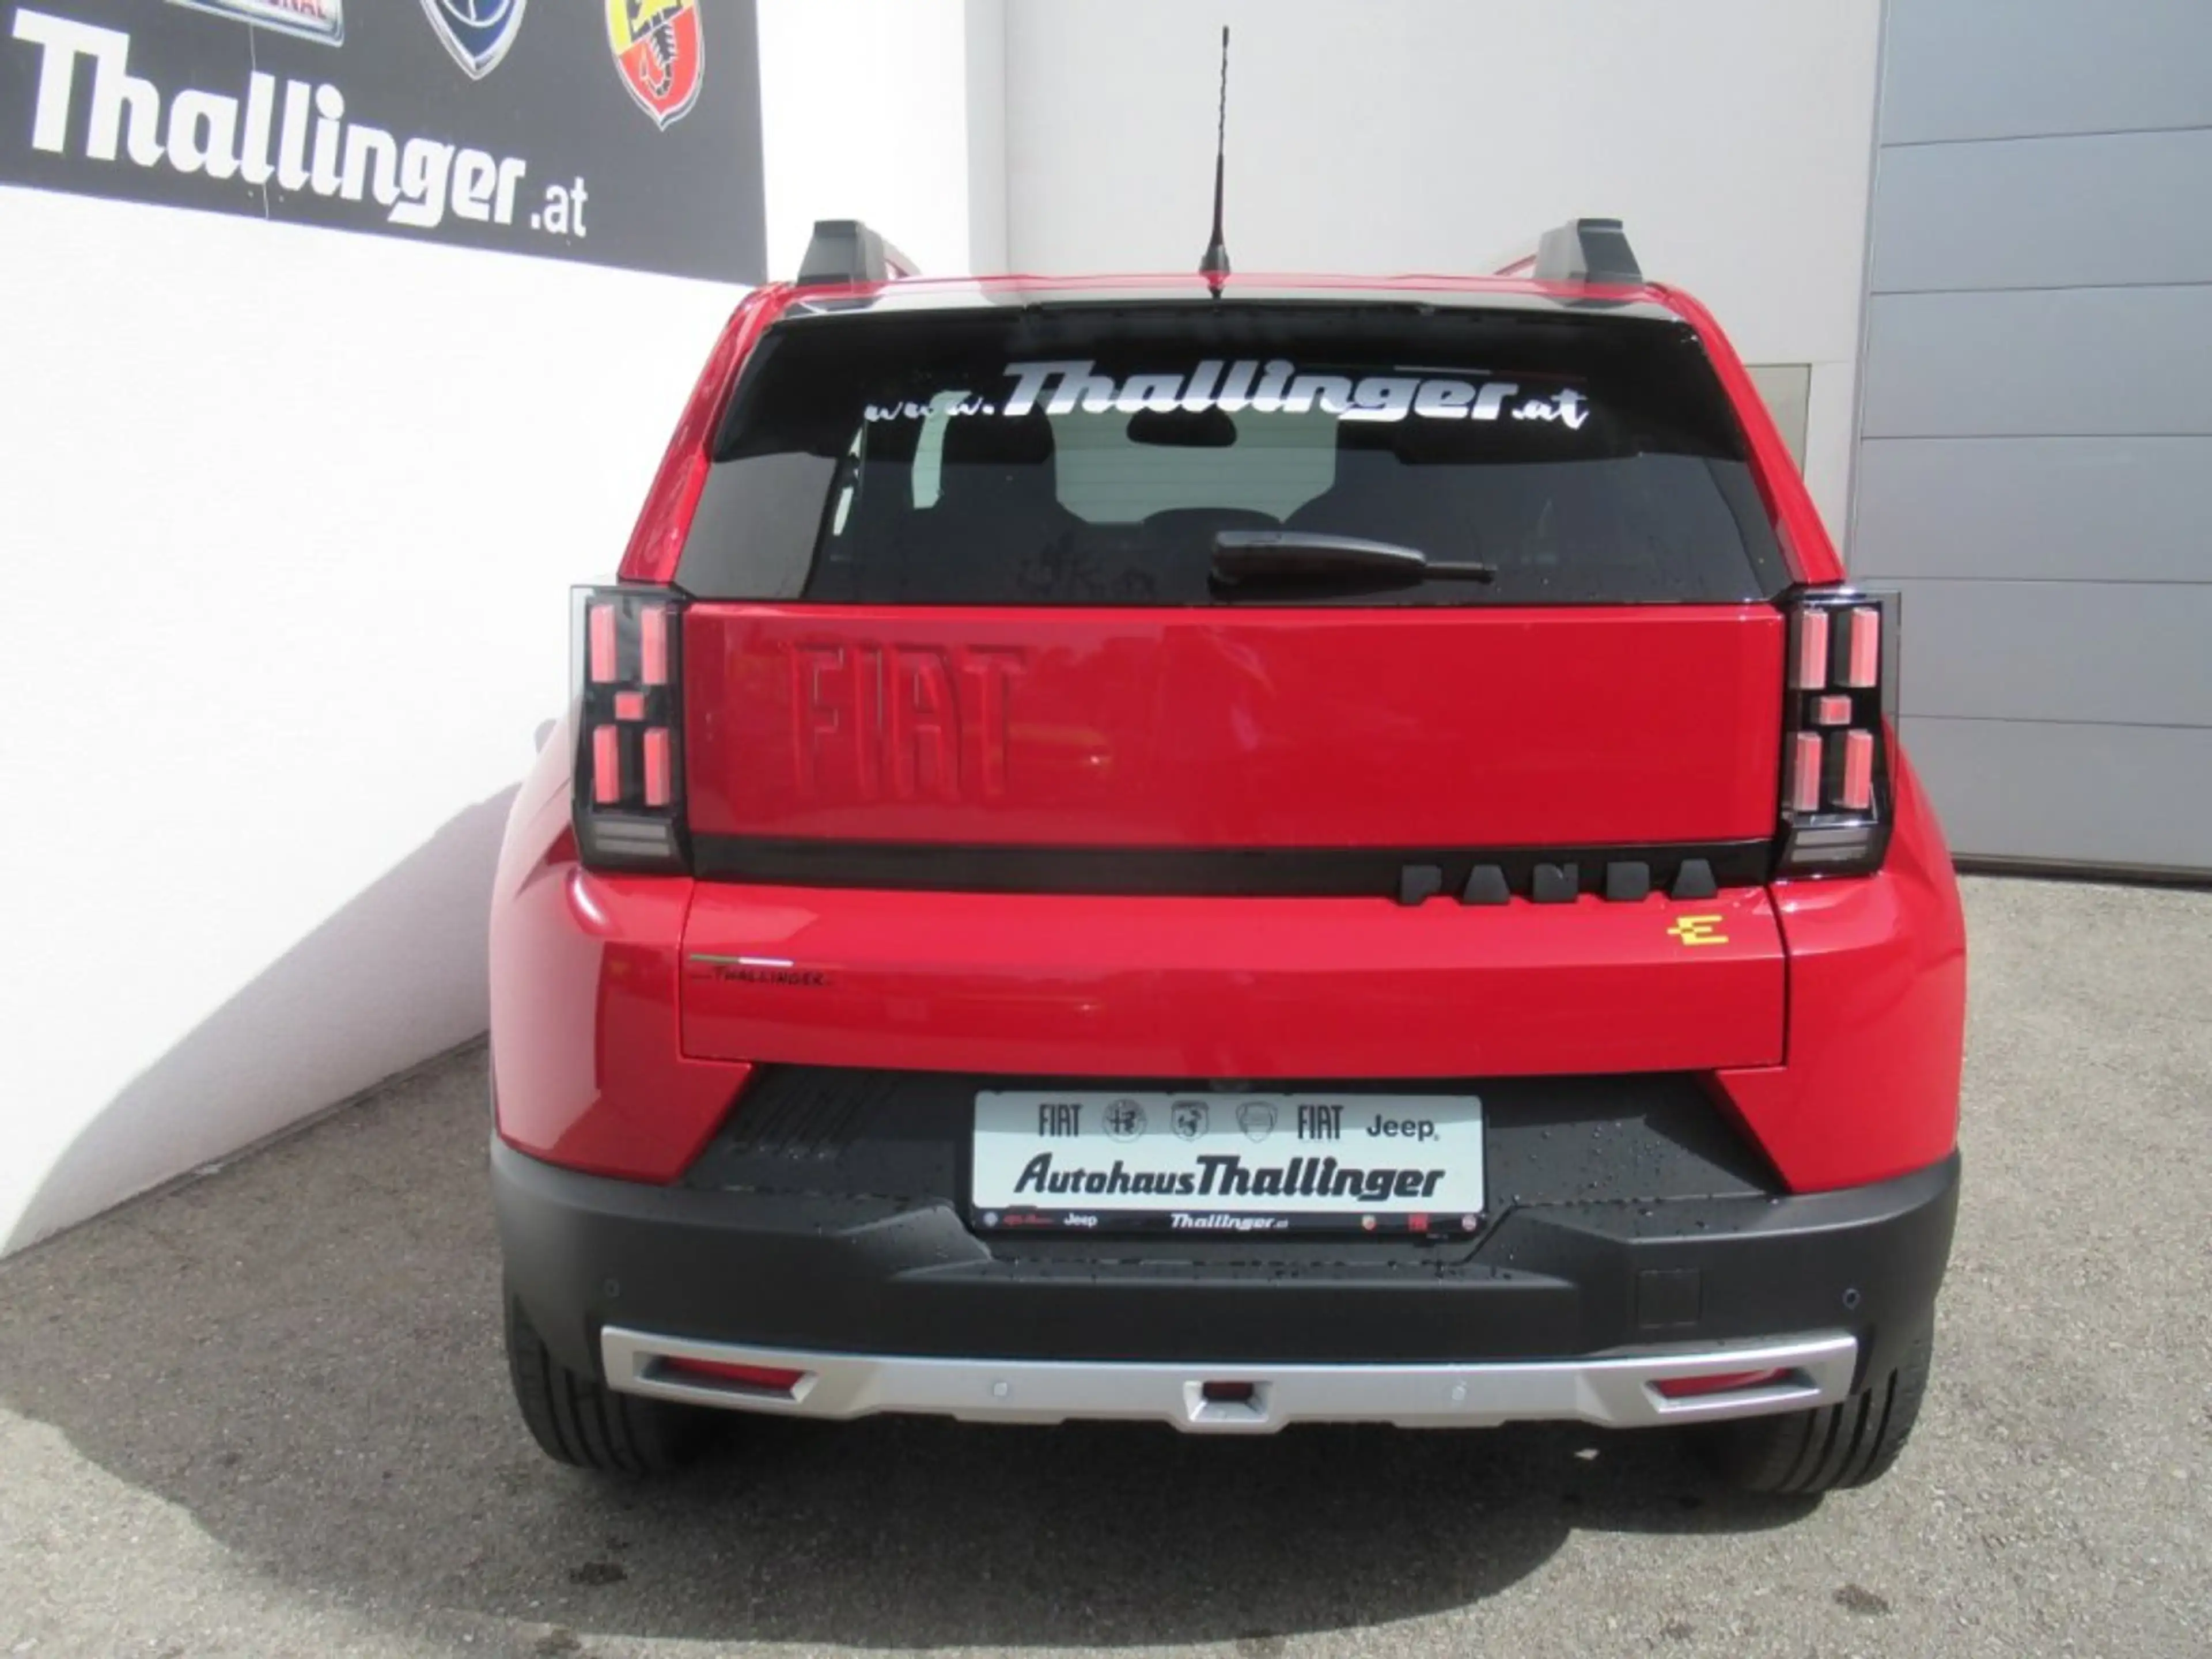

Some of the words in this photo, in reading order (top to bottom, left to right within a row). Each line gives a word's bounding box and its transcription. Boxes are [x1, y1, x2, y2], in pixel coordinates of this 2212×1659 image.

[790, 641, 1028, 801] FIAT
[1399, 859, 1718, 906] PANDA
[1039, 1103, 1083, 1138] FIAT
[1297, 1104, 1344, 1140] FIAT
[1063, 1213, 1098, 1228] Jeep
